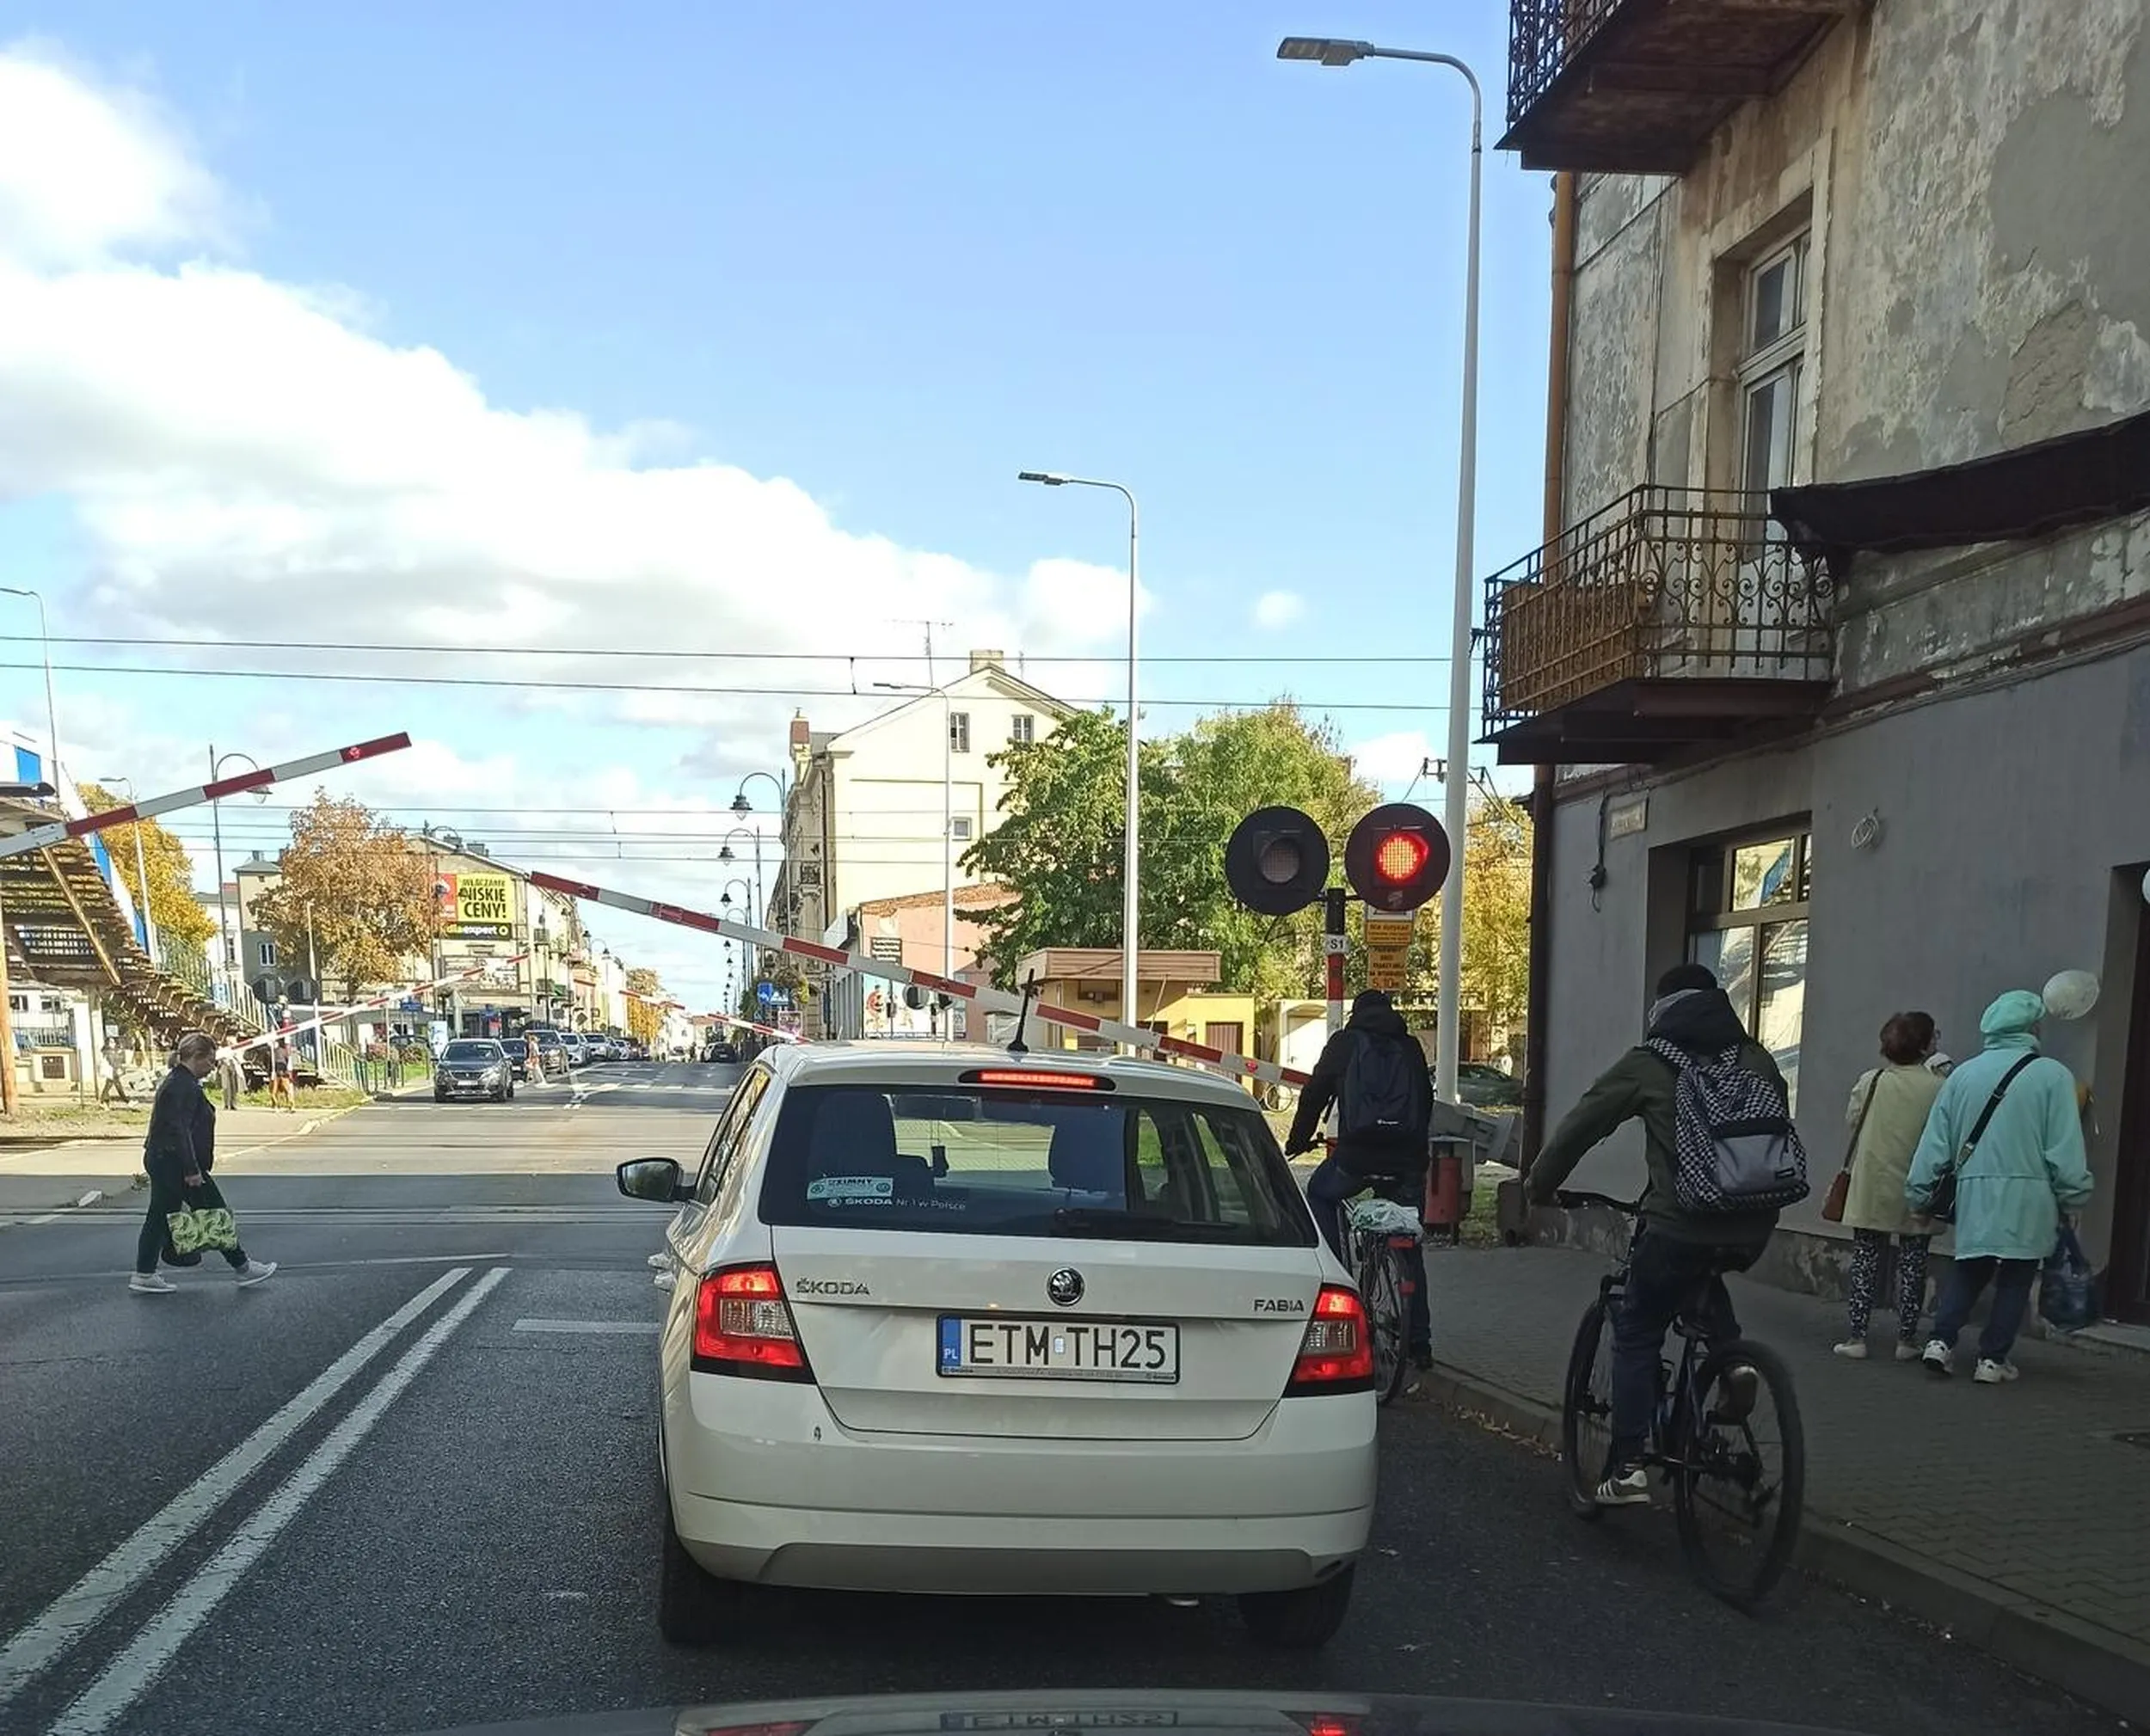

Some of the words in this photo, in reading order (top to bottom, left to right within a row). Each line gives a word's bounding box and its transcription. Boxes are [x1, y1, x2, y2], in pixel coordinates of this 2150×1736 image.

[464, 902, 507, 918] CENY!
[1330, 938, 1343, 949] S1
[796, 1277, 870, 1295] ŠKODA
[1253, 1299, 1305, 1312] FABIA
[943, 1347, 959, 1359] PL
[969, 1323, 1049, 1365] ETM
[1066, 1327, 1166, 1370] TH25
